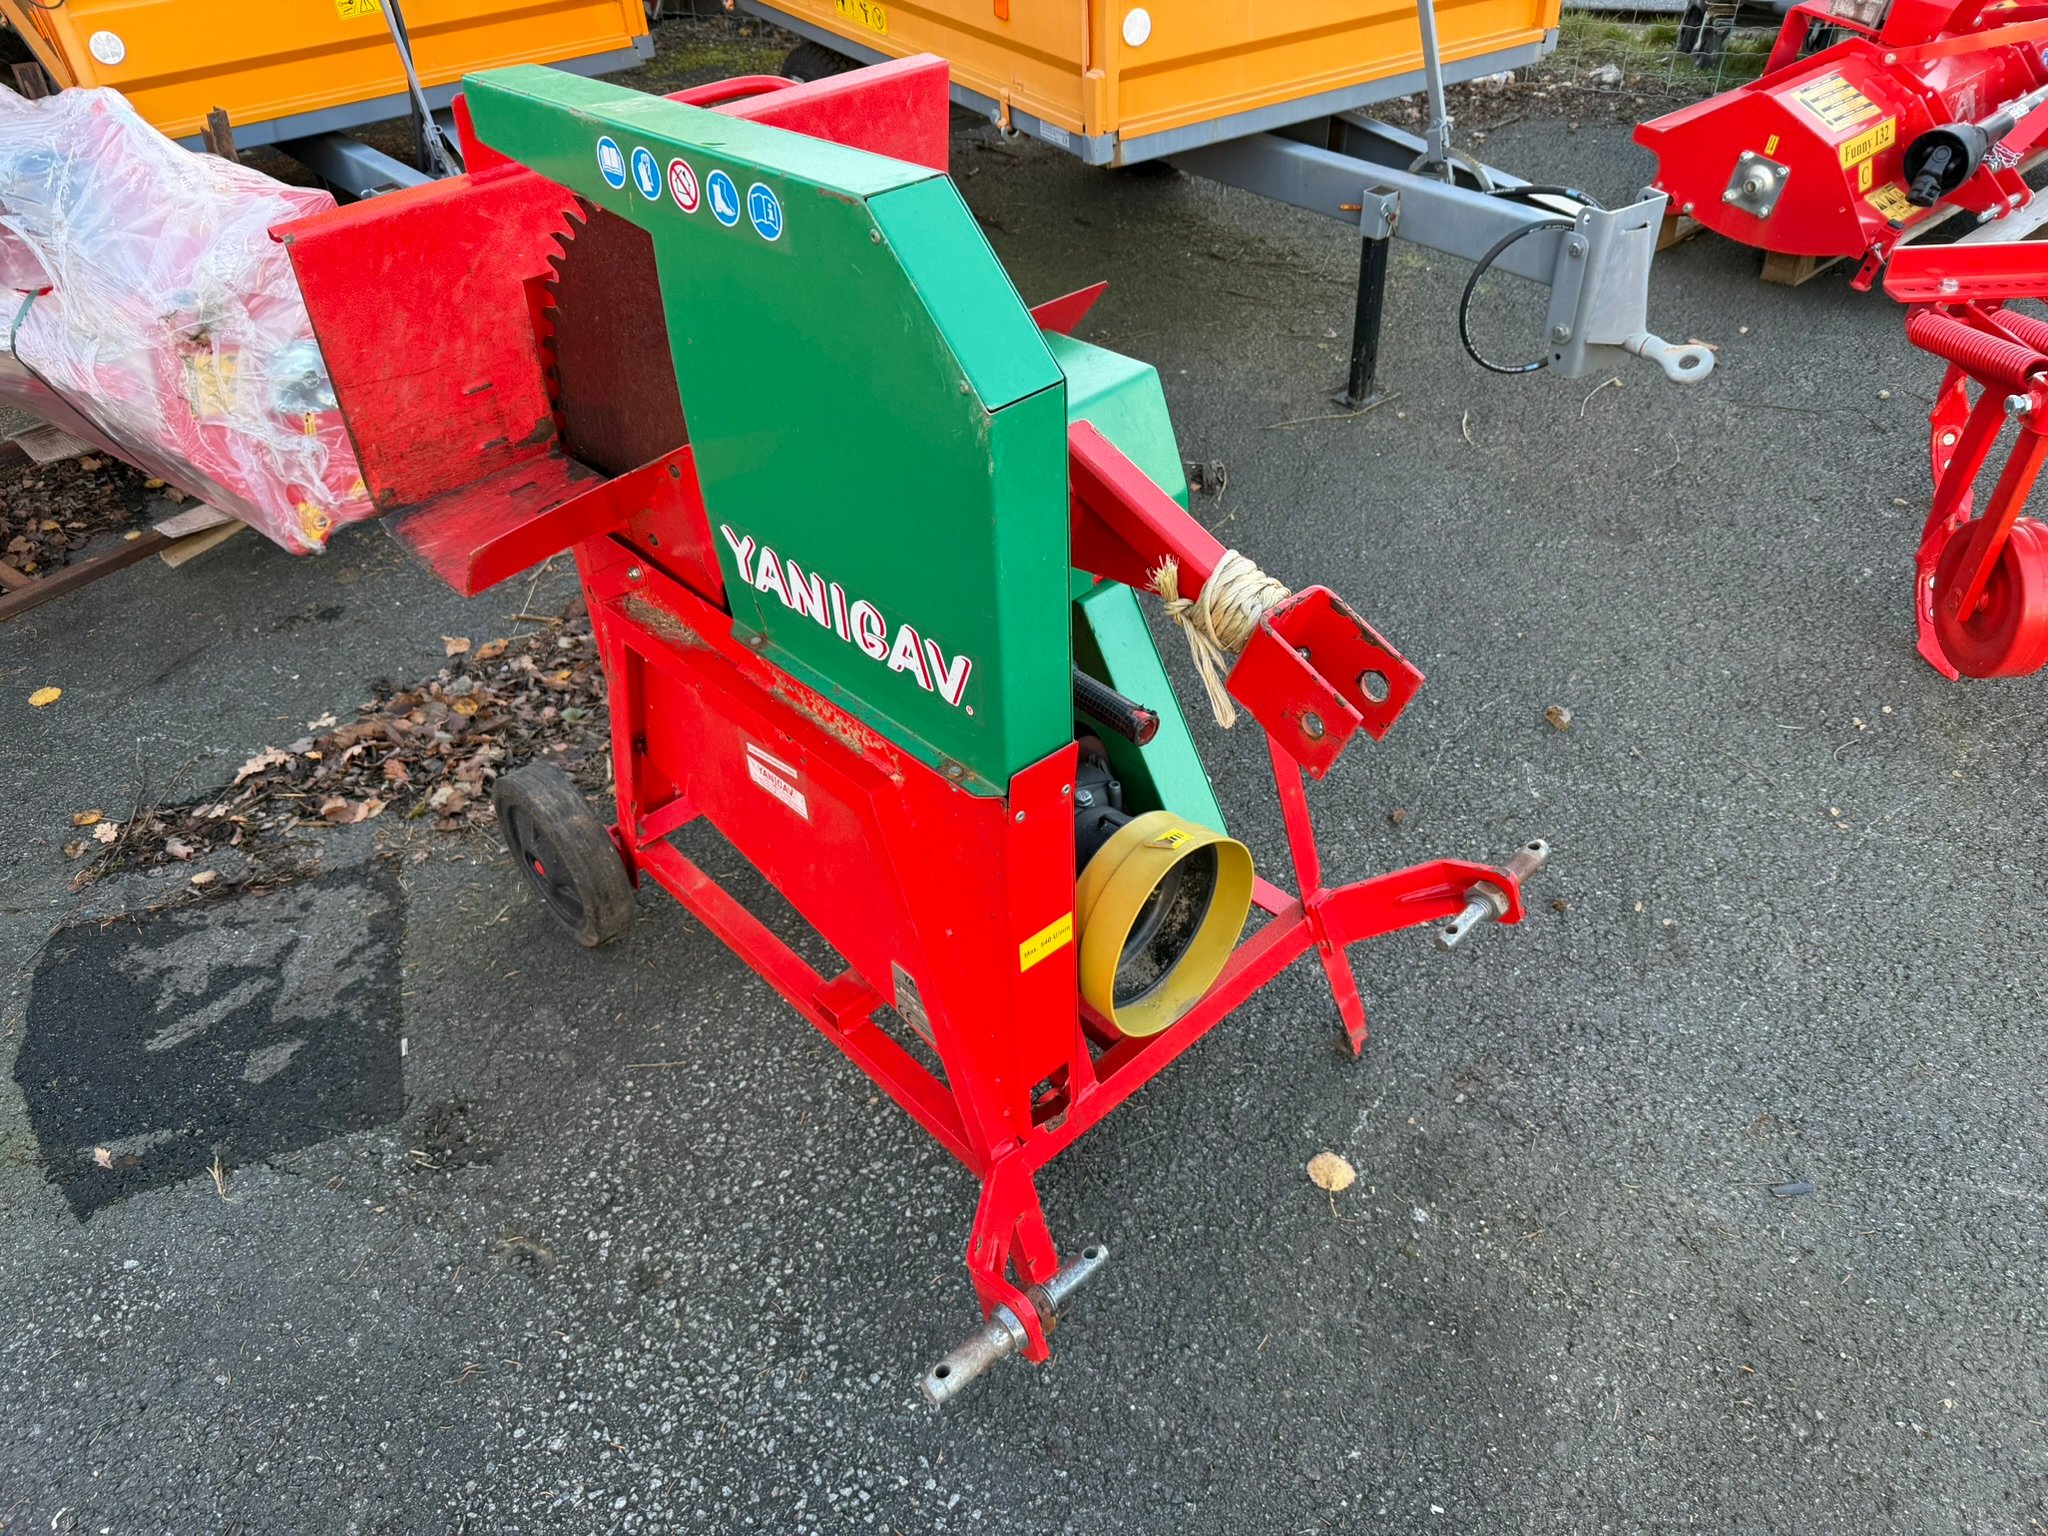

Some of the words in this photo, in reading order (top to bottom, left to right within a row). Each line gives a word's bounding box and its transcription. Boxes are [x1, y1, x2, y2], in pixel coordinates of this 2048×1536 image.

[1844, 137, 1873, 163] Funny
[1874, 125, 1890, 148] 132
[1861, 165, 1870, 185] C
[719, 523, 973, 707] YANIGAV
